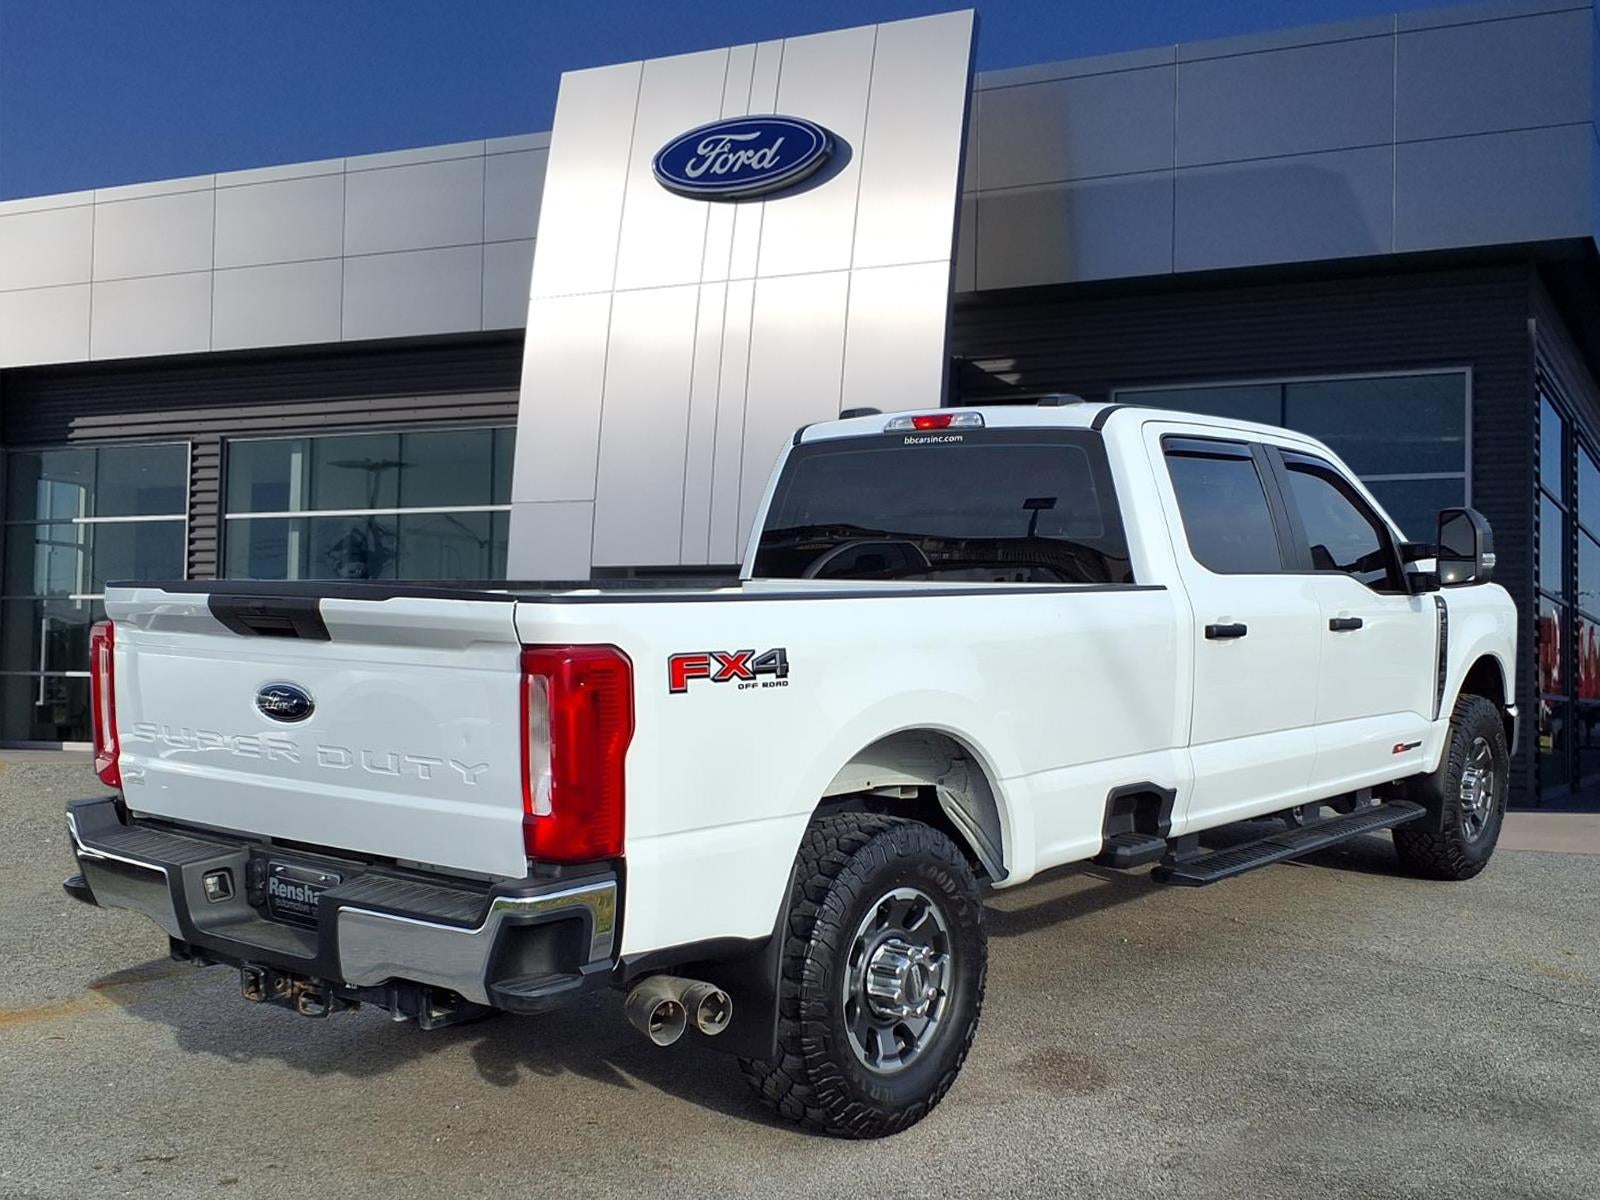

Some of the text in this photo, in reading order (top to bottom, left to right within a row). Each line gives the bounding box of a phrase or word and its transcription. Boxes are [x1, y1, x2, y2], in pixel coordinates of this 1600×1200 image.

[685, 131, 785, 178] Ford
[904, 434, 963, 445] bbcarsinc.com
[667, 647, 790, 694] FX4
[737, 680, 789, 690] OFF ROAD
[132, 721, 490, 785] SUPER DUTY
